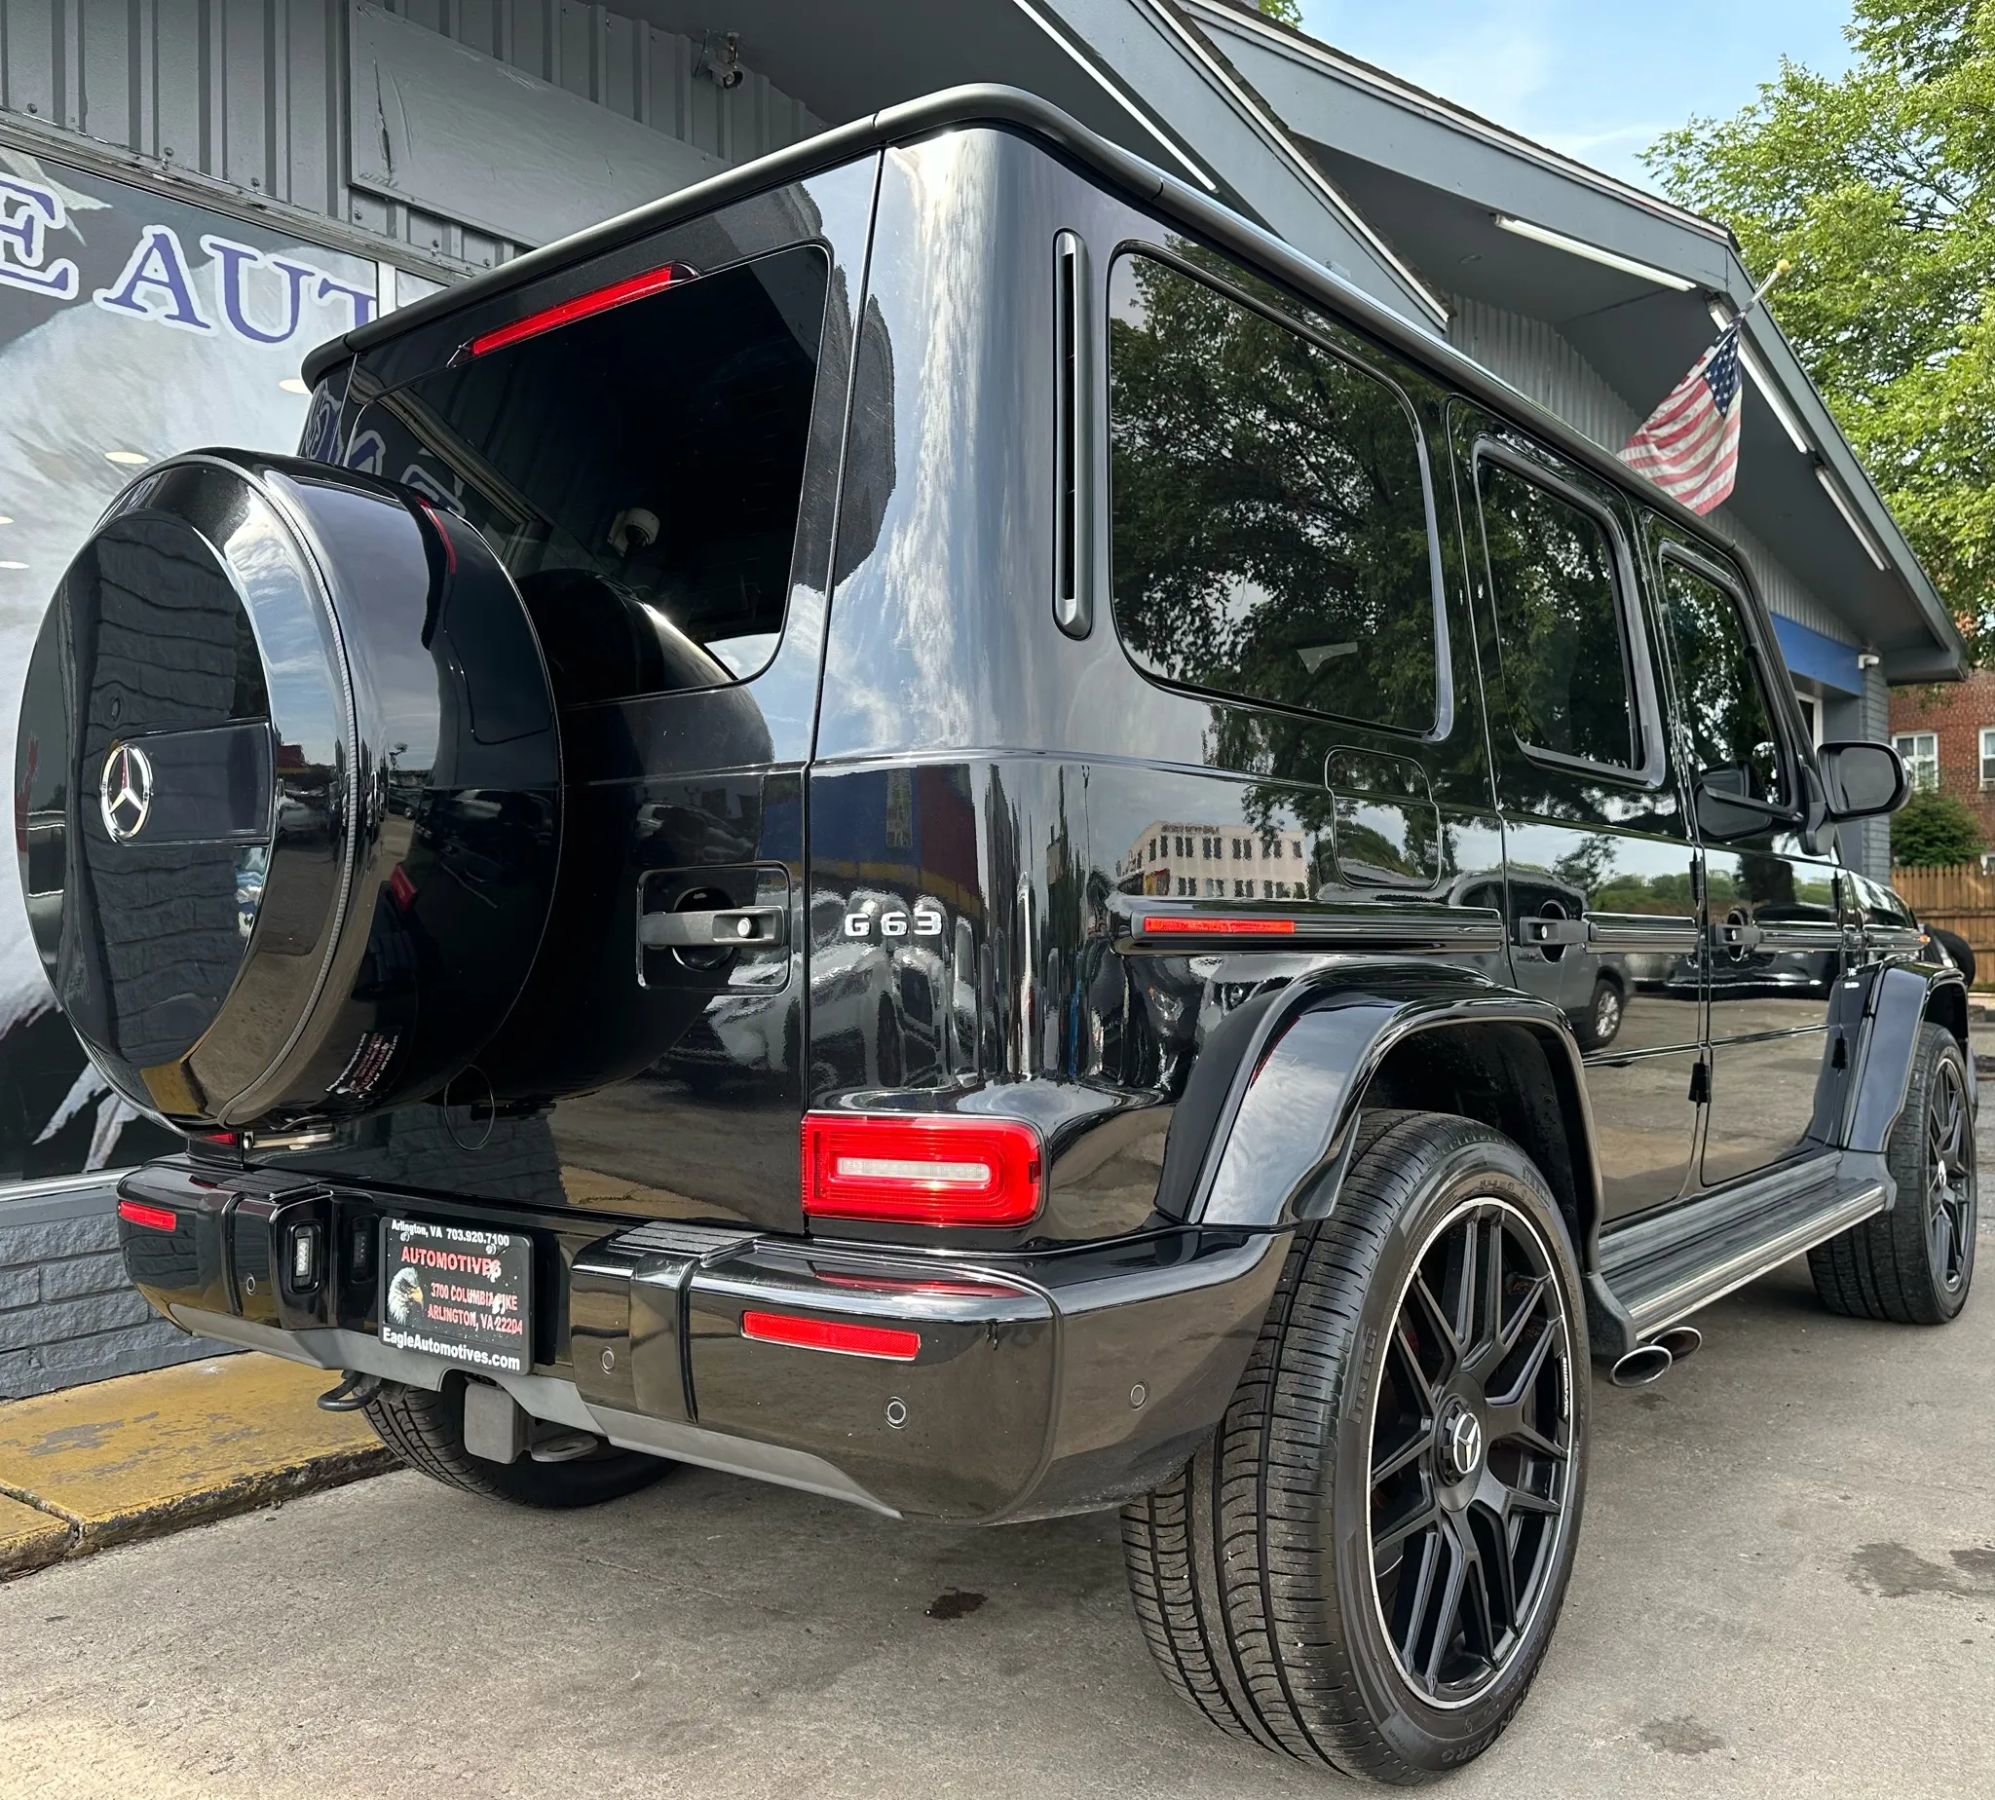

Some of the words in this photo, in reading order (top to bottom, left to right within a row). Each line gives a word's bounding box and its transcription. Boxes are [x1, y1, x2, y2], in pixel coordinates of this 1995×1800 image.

[391, 1219, 429, 1238] Arlington,
[430, 1225, 443, 1238] VA
[446, 1228, 510, 1246] 703.920.7100
[431, 1282, 449, 1299] 3700
[451, 1284, 494, 1306] COLUMBIA
[428, 1304, 479, 1331] ARLINGTON,
[480, 1313, 494, 1330] VA
[494, 1315, 523, 1335] 22204
[383, 1327, 521, 1371] EagleAutomotives.com
